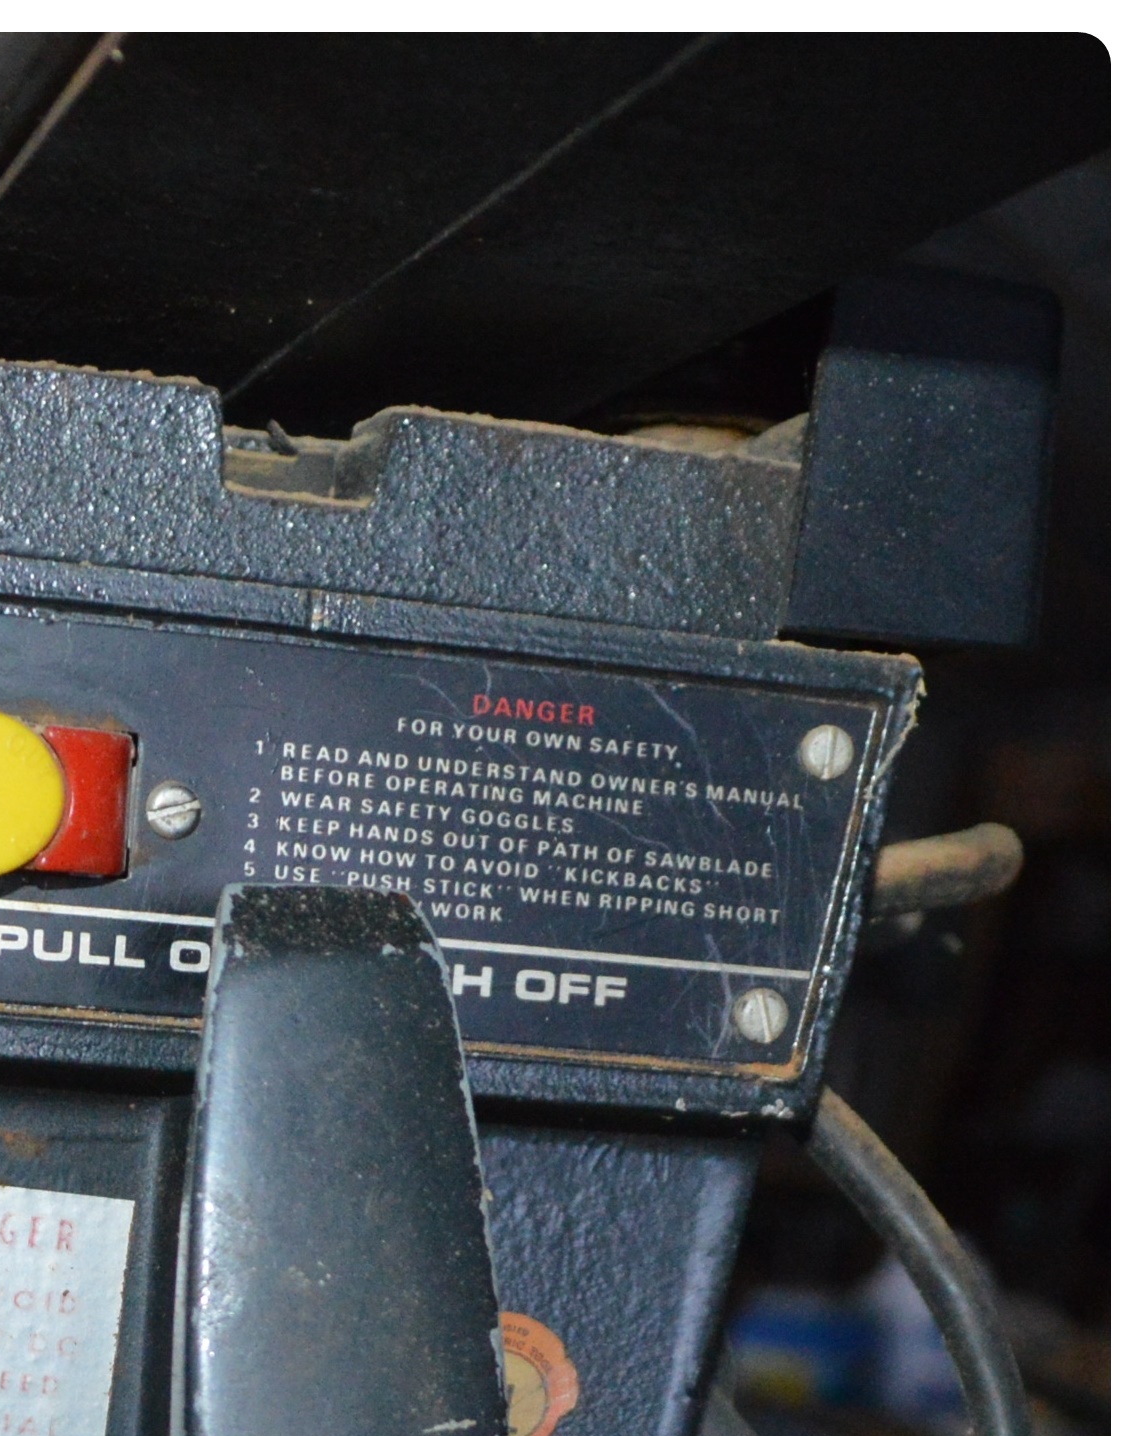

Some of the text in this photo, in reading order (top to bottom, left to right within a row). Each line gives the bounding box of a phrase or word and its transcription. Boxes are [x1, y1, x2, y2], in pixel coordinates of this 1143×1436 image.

[472, 693, 596, 726] DANGER
[397, 717, 443, 737] FOR
[453, 723, 516, 745] YOUR
[525, 730, 582, 751] OWN
[255, 740, 804, 811] 1 READ AND UNDERSTAND OWNER'S MANUAL
[281, 766, 644, 815] BEFORE OPERATING MACHINE
[249, 788, 574, 833] 2 WEAR SAFETY GOGGLES
[244, 839, 256, 853] 4
[276, 842, 351, 862] KNOW
[360, 849, 416, 868] HOW
[425, 854, 455, 871] TO
[464, 858, 539, 879] AVOID
[247, 813, 773, 878] 3 KEEP HANDS OUT OF PATH OF SAWBLADE
[244, 862, 256, 877] 5
[275, 865, 320, 883] USE
[520, 887, 590, 907] WHEN
[599, 894, 696, 917] RIPPING
[704, 903, 781, 925] SHORT
[432, 902, 503, 922] WORK
[169, 940, 211, 973] O
[515, 969, 628, 1007] OFF
